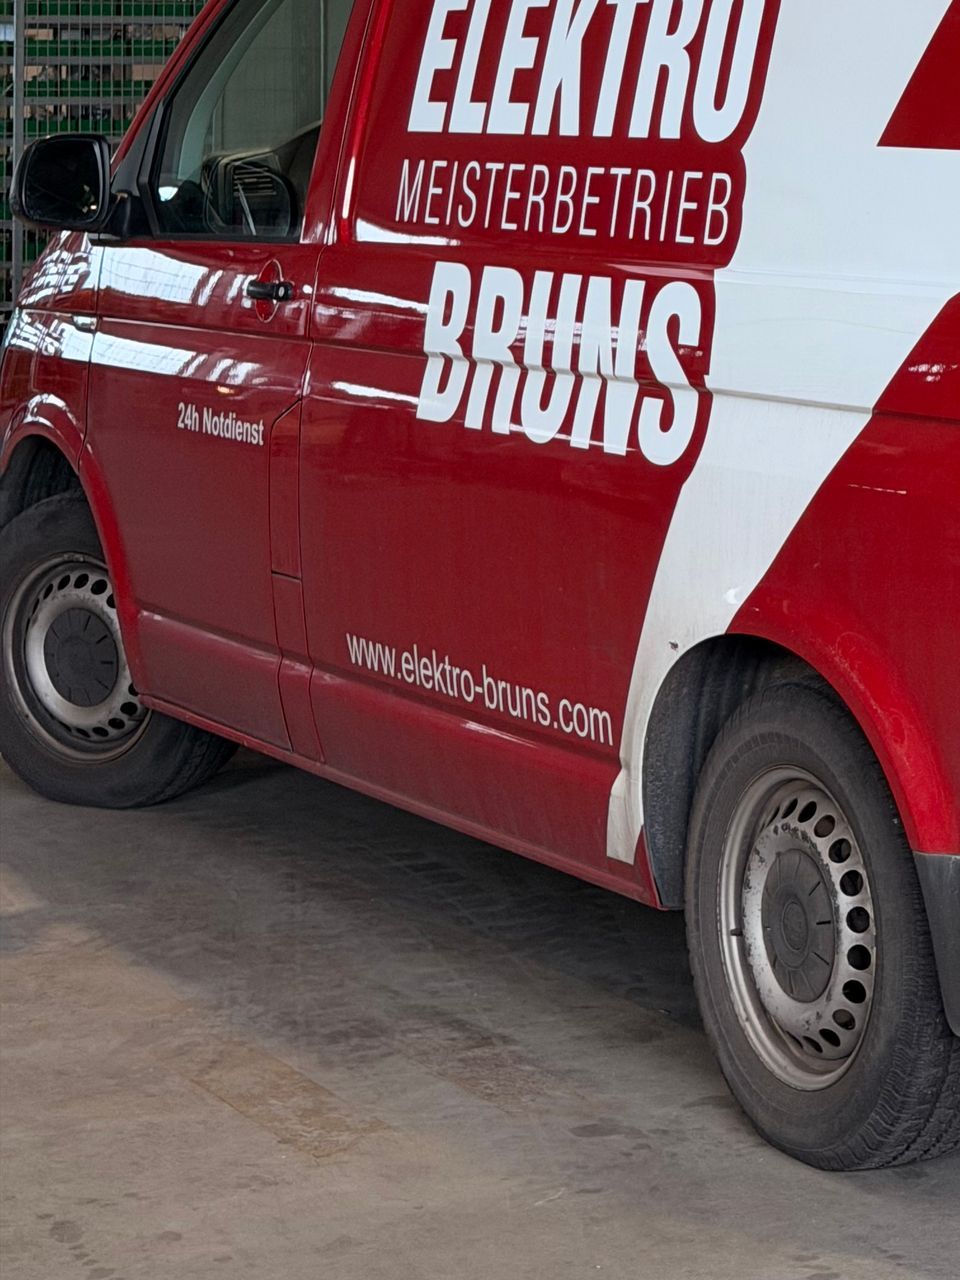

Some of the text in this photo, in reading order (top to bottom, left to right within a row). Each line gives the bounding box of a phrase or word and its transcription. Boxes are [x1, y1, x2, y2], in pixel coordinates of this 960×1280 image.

[396, 159, 732, 245] MEISTERBETRIEB
[416, 261, 703, 466] BRUNS
[177, 402, 265, 446] 24h Notdienst
[346, 633, 614, 746] www.elektro-bruns.com
